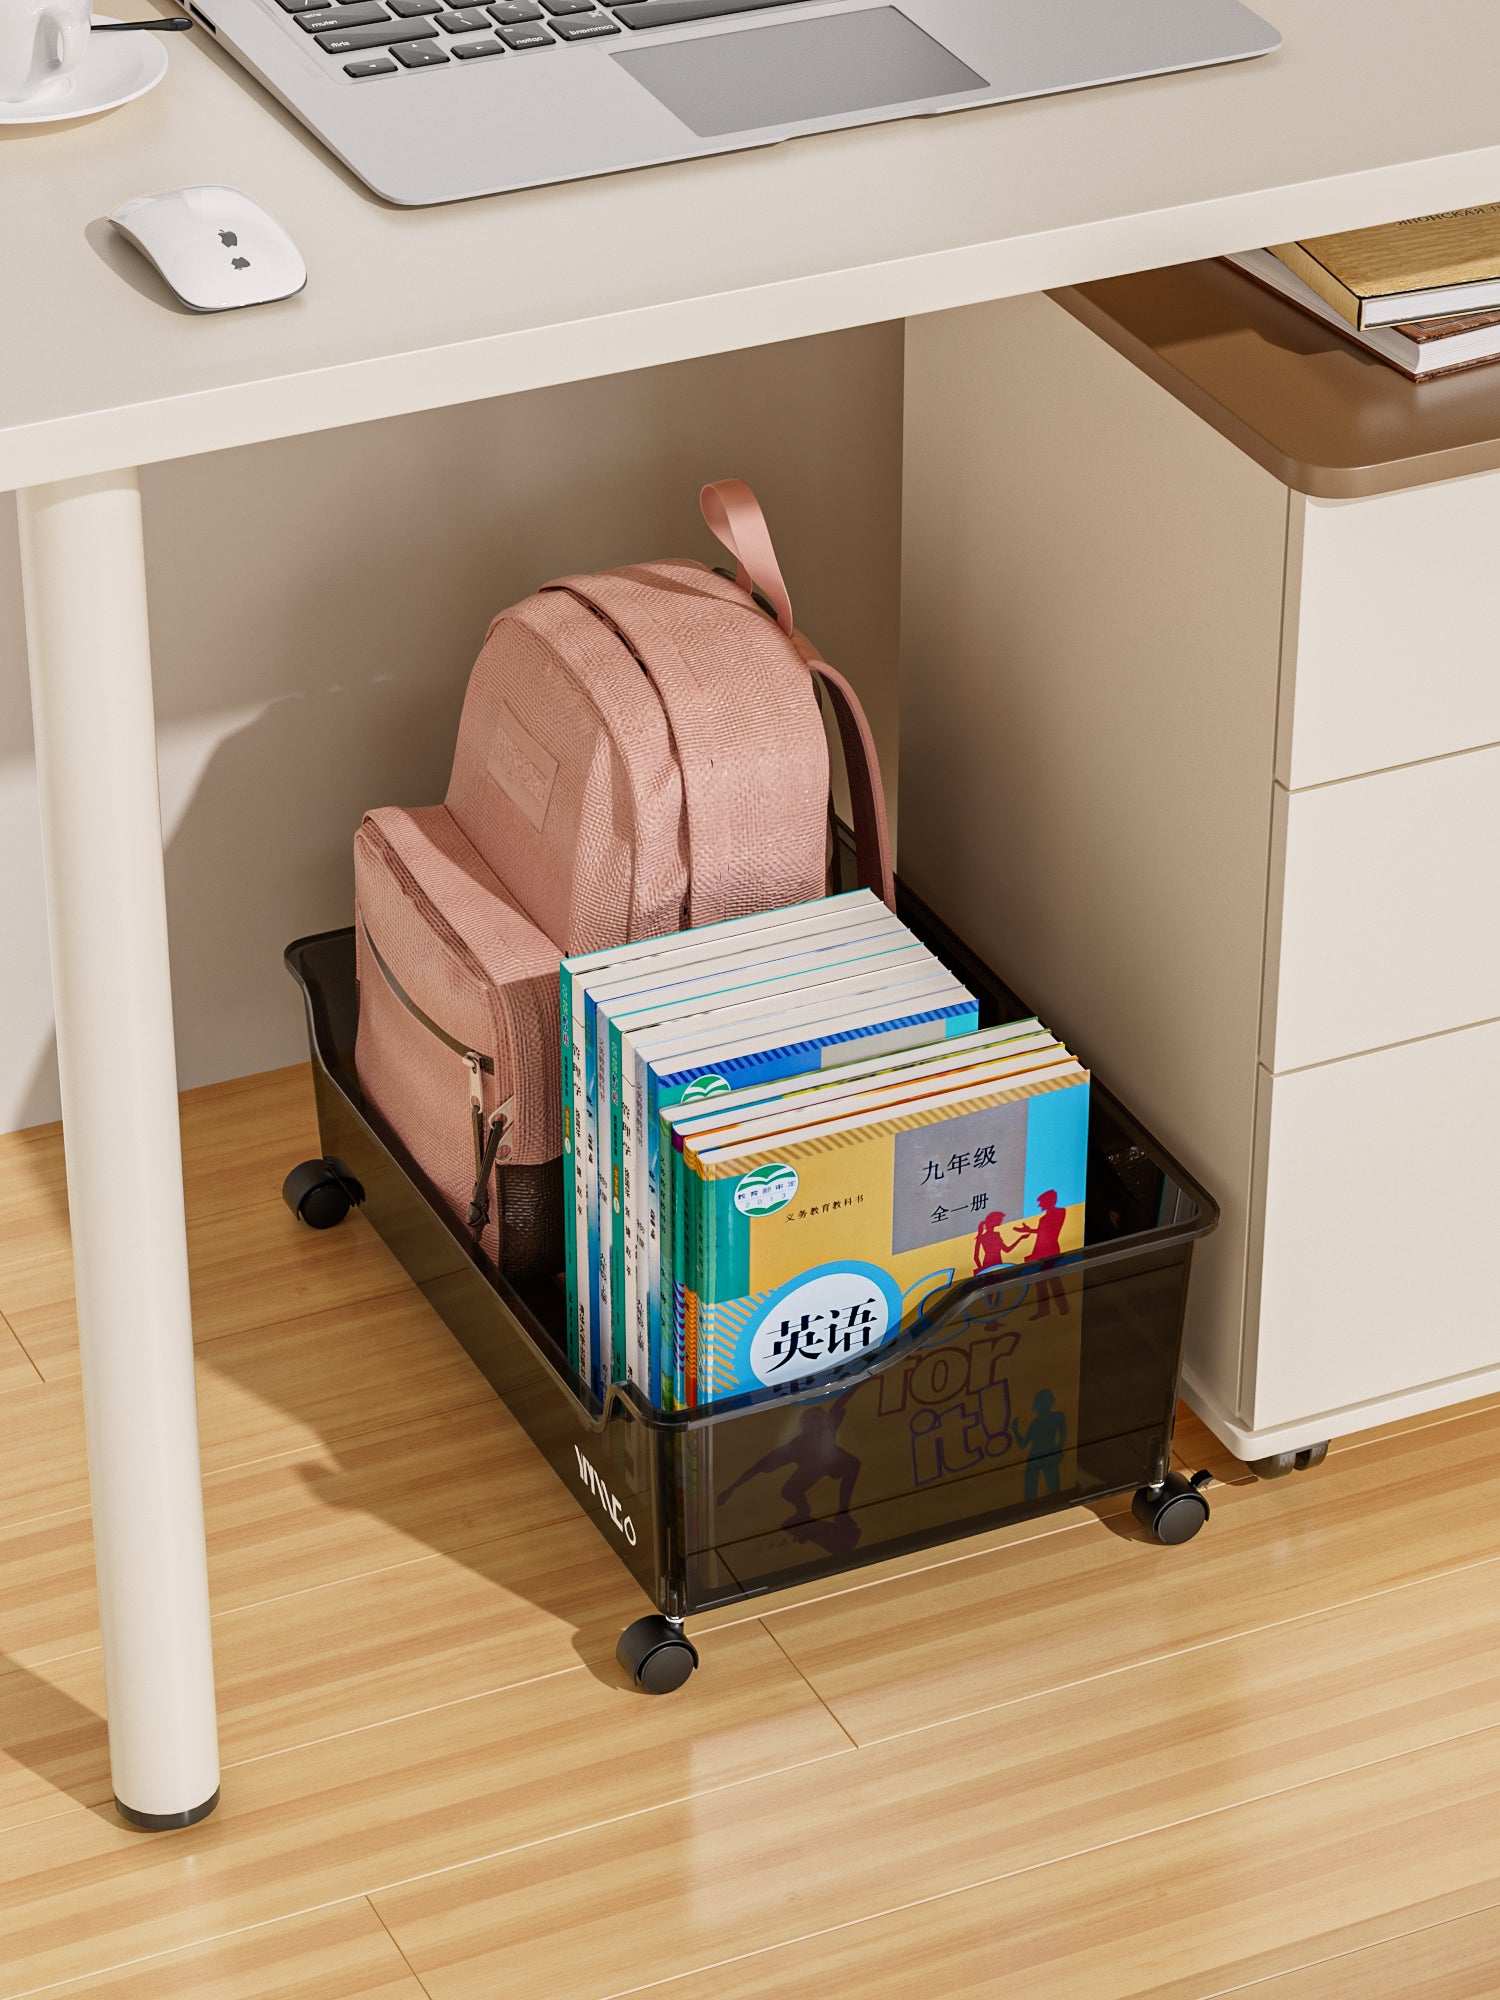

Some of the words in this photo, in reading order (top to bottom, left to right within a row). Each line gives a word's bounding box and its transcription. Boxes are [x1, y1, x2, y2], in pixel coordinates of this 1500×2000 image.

[920, 1145, 998, 1186] 九年级
[738, 1180, 796, 1201] 教育部审定
[744, 1193, 787, 1209] 2013
[784, 1195, 865, 1223] 义务教育教科书
[930, 1192, 989, 1224] 全一册
[766, 1297, 878, 1374] 英语
[909, 1378, 1013, 1488] it!
